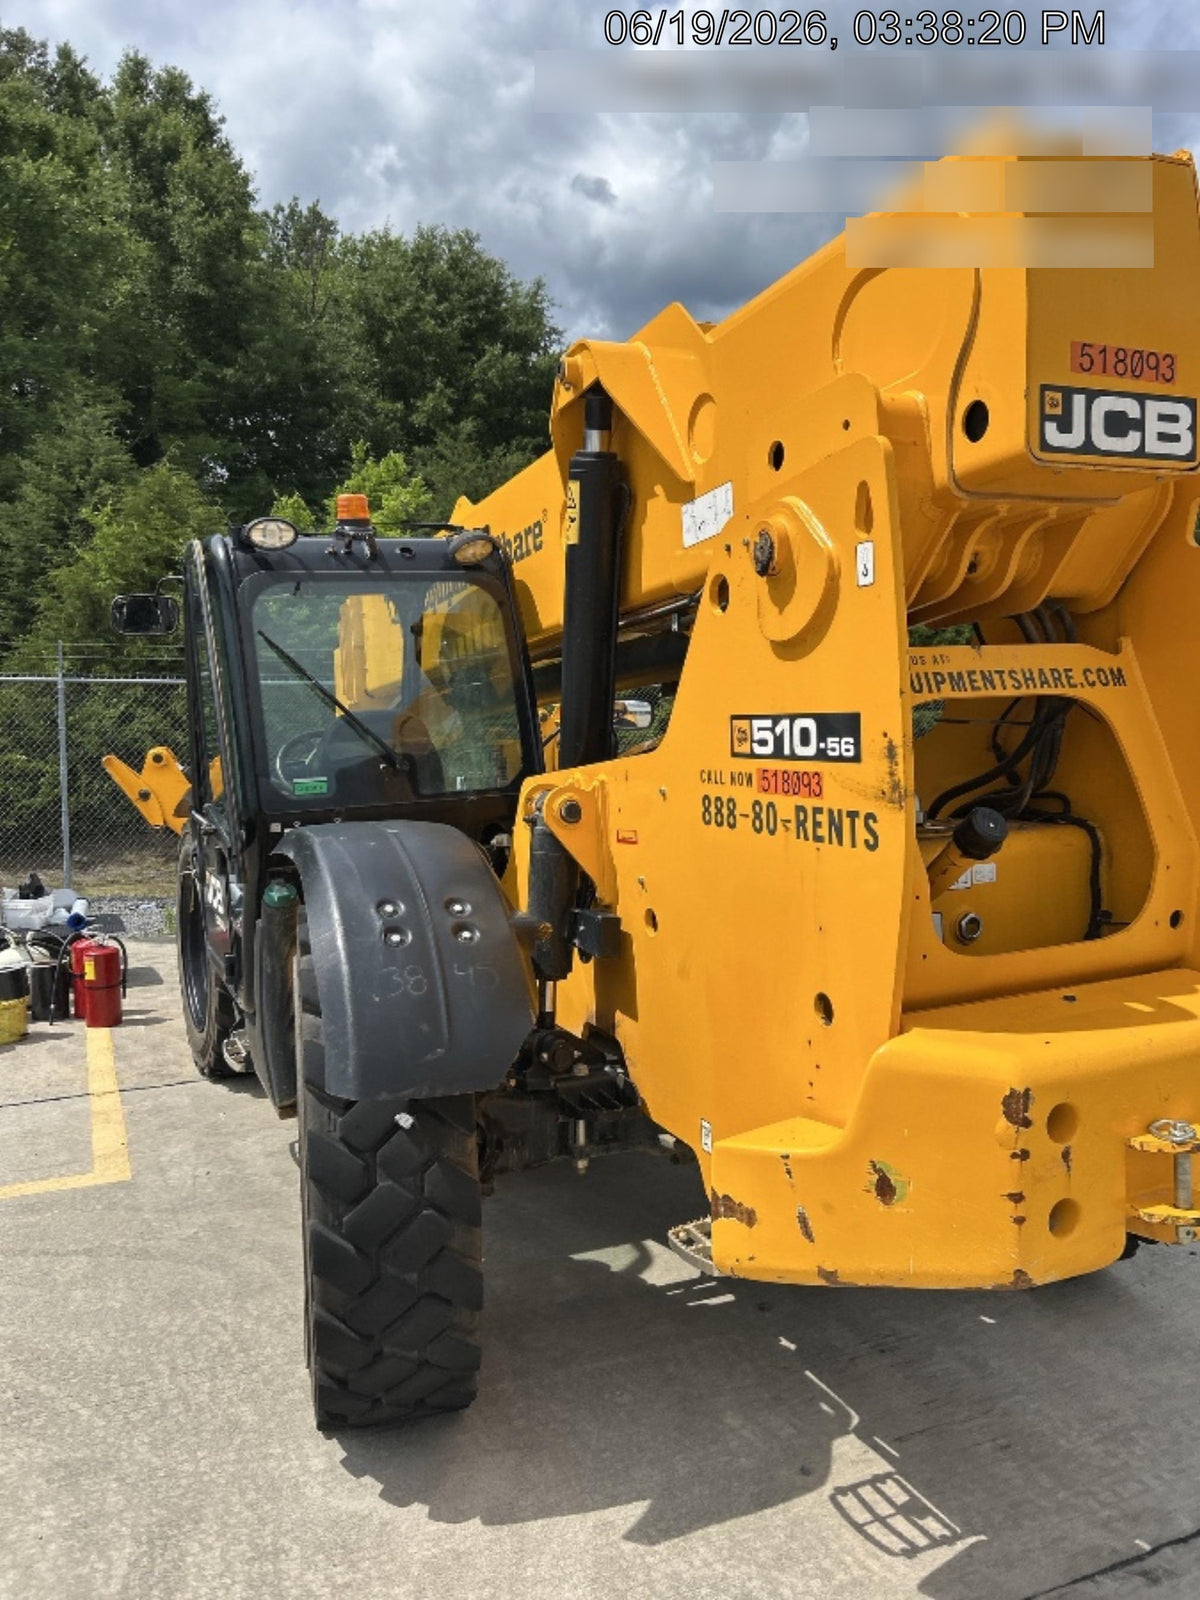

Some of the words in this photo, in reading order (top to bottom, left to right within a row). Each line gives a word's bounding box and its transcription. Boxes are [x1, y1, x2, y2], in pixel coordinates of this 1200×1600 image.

[1079, 342, 1175, 383] 518093
[1044, 394, 1194, 456] JCB
[496, 519, 543, 563] hare
[909, 666, 1127, 695] UIPMENTSHARE.COM
[751, 718, 855, 757] 510-56
[700, 769, 726, 785] CALL
[730, 771, 753, 788] NOW
[761, 769, 822, 798] 518093
[702, 794, 879, 852] 888-80-RENTS
